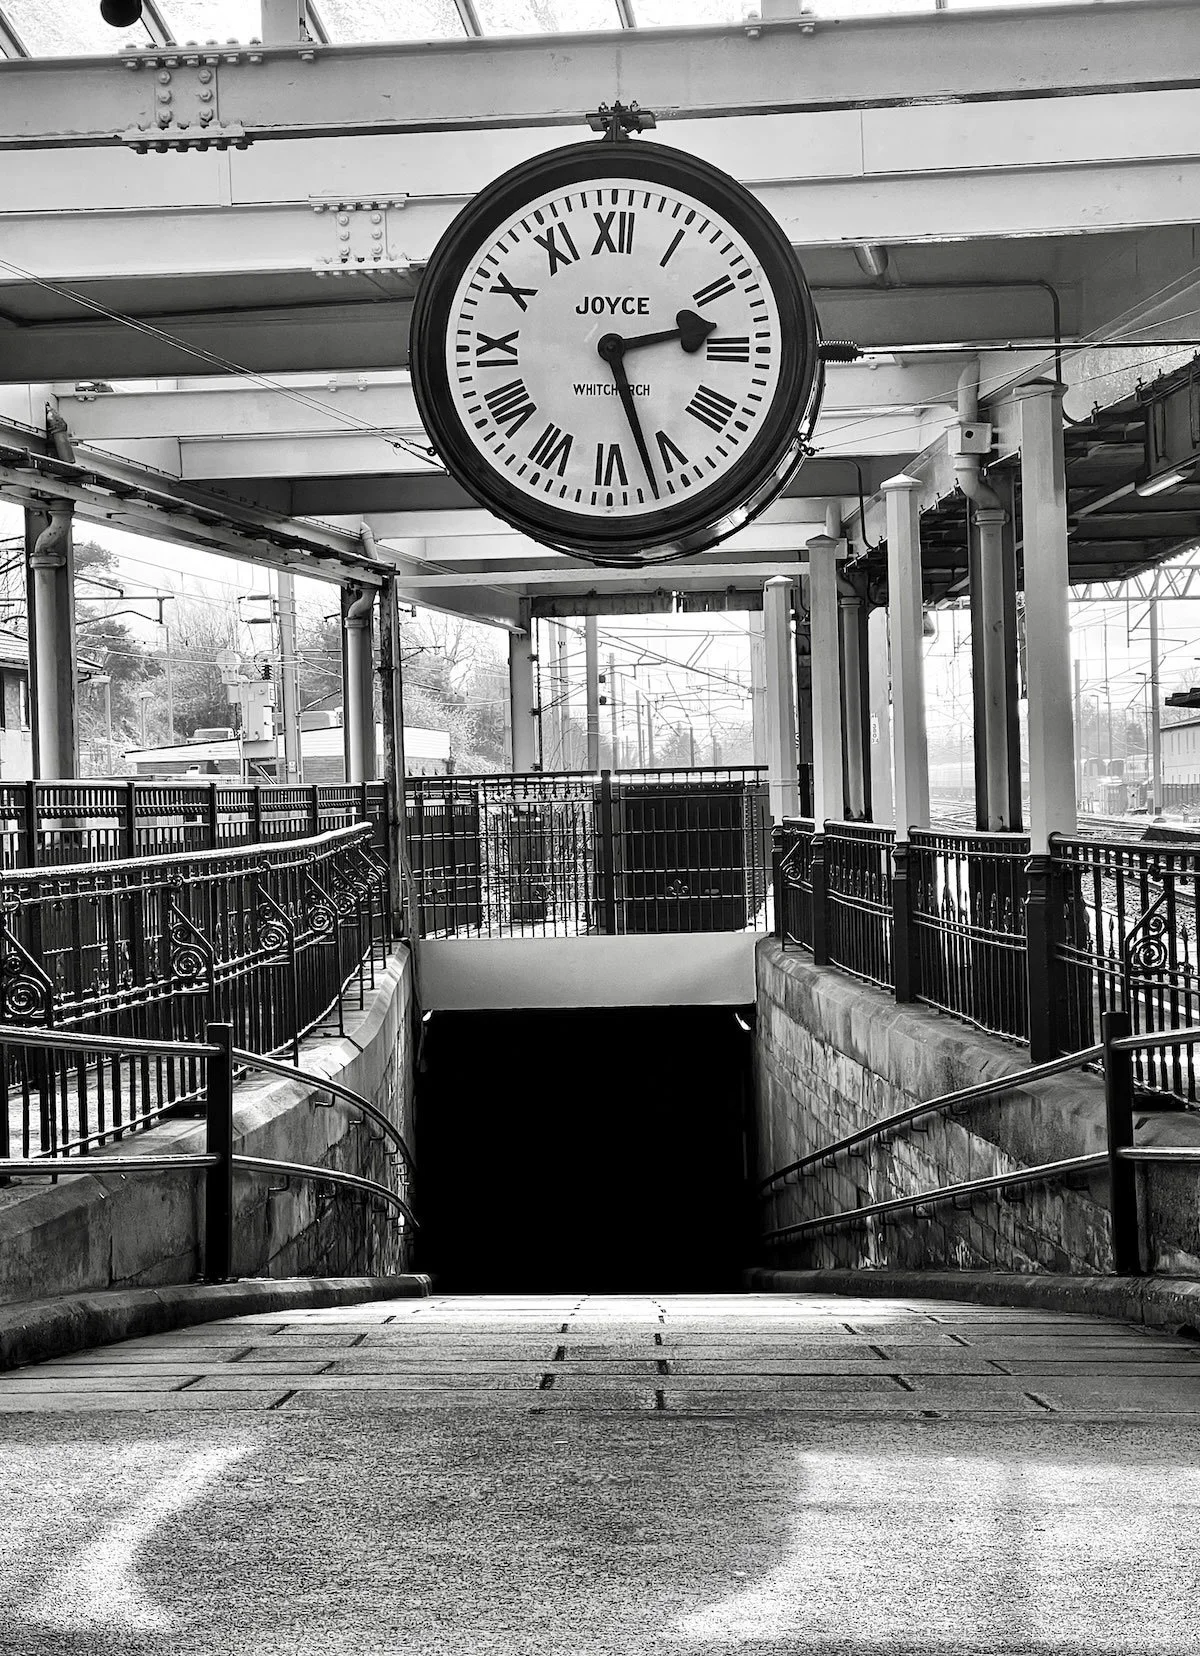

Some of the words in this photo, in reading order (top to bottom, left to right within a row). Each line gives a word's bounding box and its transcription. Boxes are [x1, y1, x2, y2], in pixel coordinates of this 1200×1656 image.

[533, 222, 580, 276] XI
[591, 212, 635, 255] XII
[489, 272, 538, 312] X
[575, 296, 650, 315] JOYCE
[476, 330, 519, 368] IX
[706, 336, 750, 363] III
[484, 378, 537, 439] VIII
[573, 383, 650, 396] WHITCHRCH
[685, 385, 737, 433] IIII
[528, 423, 573, 477] VII
[595, 443, 628, 487] VI
[655, 430, 689, 474] V
